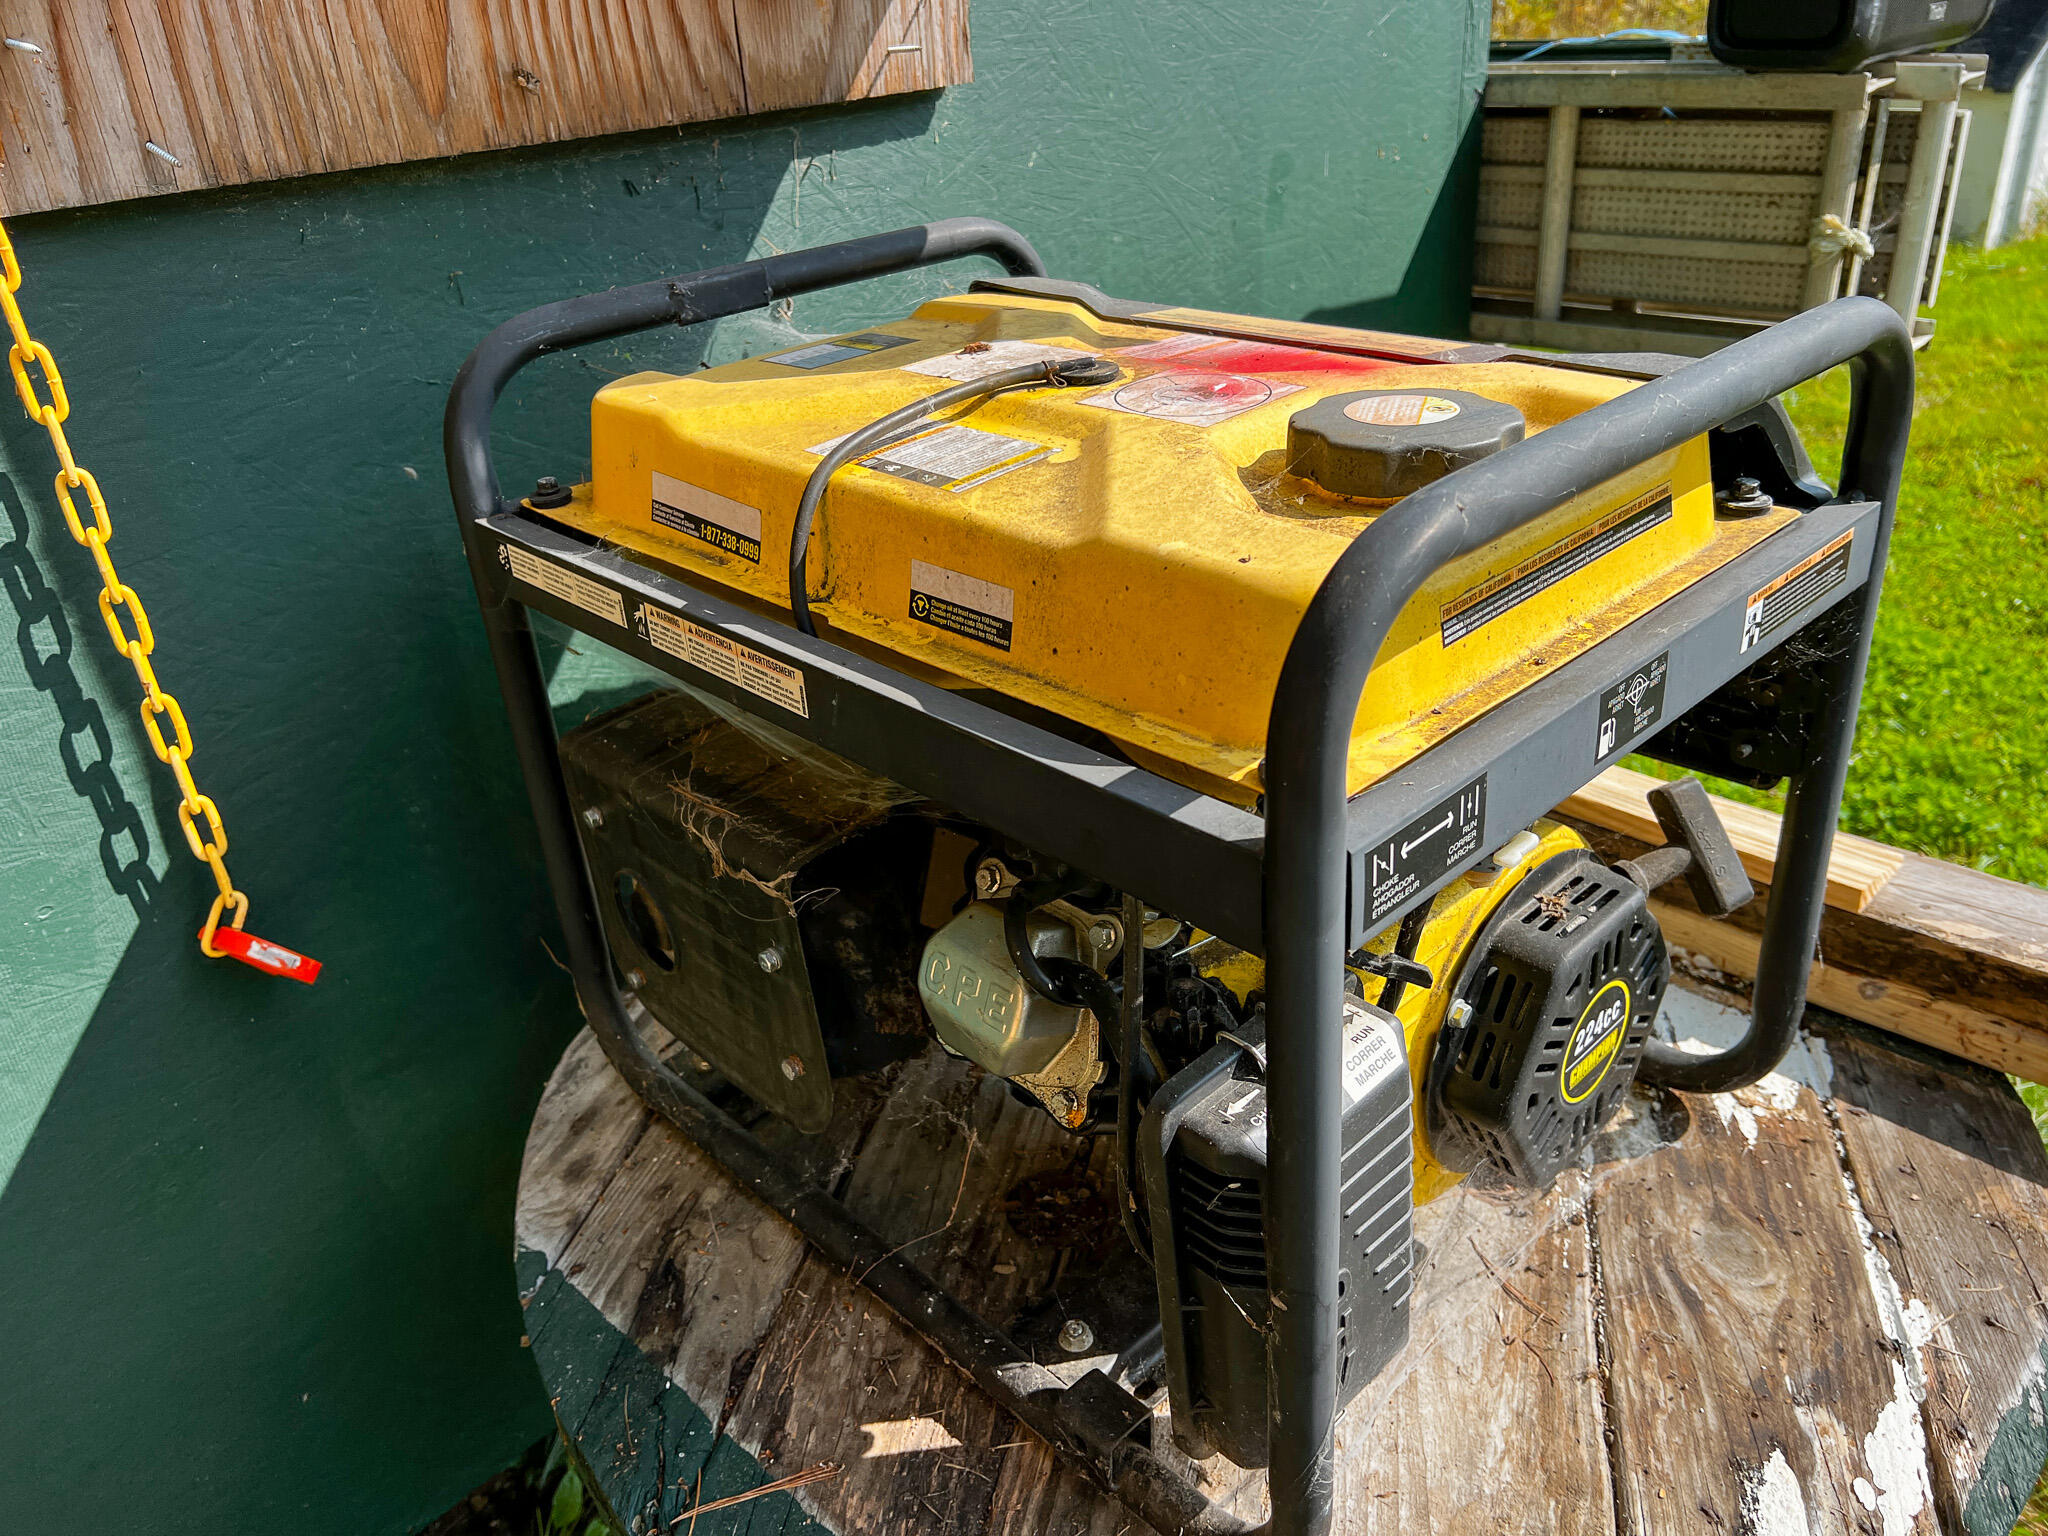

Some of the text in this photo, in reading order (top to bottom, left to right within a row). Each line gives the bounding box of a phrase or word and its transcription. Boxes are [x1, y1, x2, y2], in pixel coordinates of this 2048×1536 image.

[1599, 518, 1609, 530] POUR
[700, 522, 758, 561] 1-877-338-0999
[1517, 563, 1528, 575] PARA
[1529, 558, 1537, 569] LOS
[1538, 544, 1563, 564] RESIDENTES
[1564, 541, 1568, 550] DE
[1442, 605, 1452, 617] FOR
[1452, 591, 1477, 612] RESIDENTS
[1478, 588, 1483, 598] OF
[655, 609, 680, 628] WARNING
[957, 608, 968, 617] least
[968, 612, 980, 621] every
[981, 616, 989, 624] 100
[989, 619, 1002, 628] hours
[975, 621, 983, 629] 100
[983, 624, 996, 634] horas
[694, 627, 733, 652] ADVERTENCIA
[993, 635, 1009, 646] heures
[746, 650, 796, 680] AVERTISSEMENT
[1618, 682, 1626, 693] OFF
[1462, 818, 1478, 835] RUN
[1446, 840, 1476, 866] MARCHE
[1448, 830, 1477, 855] CORRER
[1372, 873, 1400, 898] CHOKE
[1372, 873, 1415, 909] AHOGADOR
[1372, 880, 1420, 920] ÉTRANGLEUR
[925, 951, 1014, 1034] CPE
[1350, 1025, 1375, 1044] RUN
[1574, 999, 1621, 1056] 224cc
[1345, 1034, 1387, 1072] CORRER
[1354, 1048, 1397, 1087] MARCHE
